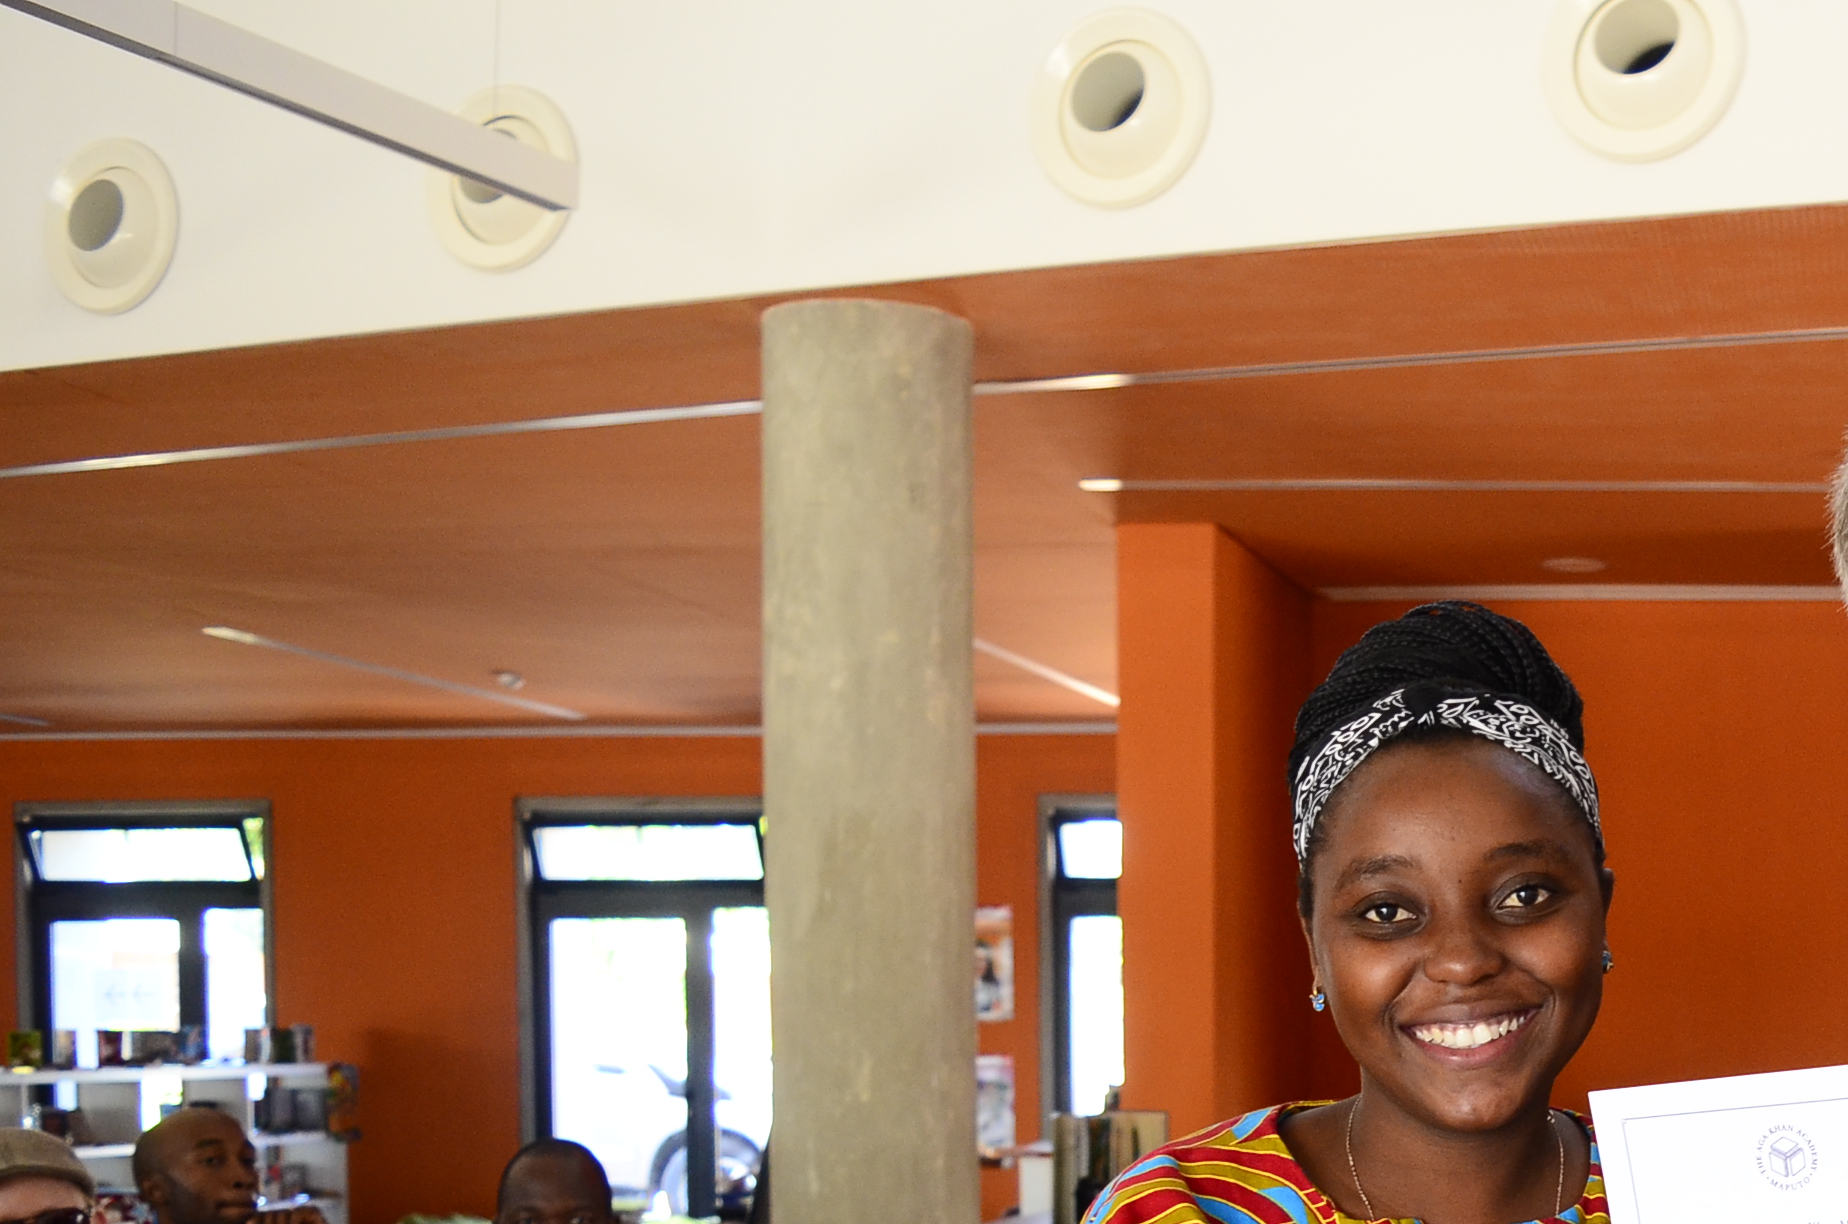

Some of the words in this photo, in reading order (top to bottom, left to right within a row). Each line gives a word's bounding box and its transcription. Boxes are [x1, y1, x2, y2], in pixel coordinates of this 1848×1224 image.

[1768, 1124, 1794, 1135] KHAN
[1756, 1134, 1769, 1152] AGA
[1795, 1129, 1819, 1173] ACADEMY
[1755, 1156, 1767, 1175] THE
[1769, 1175, 1811, 1192] MAPUTO
